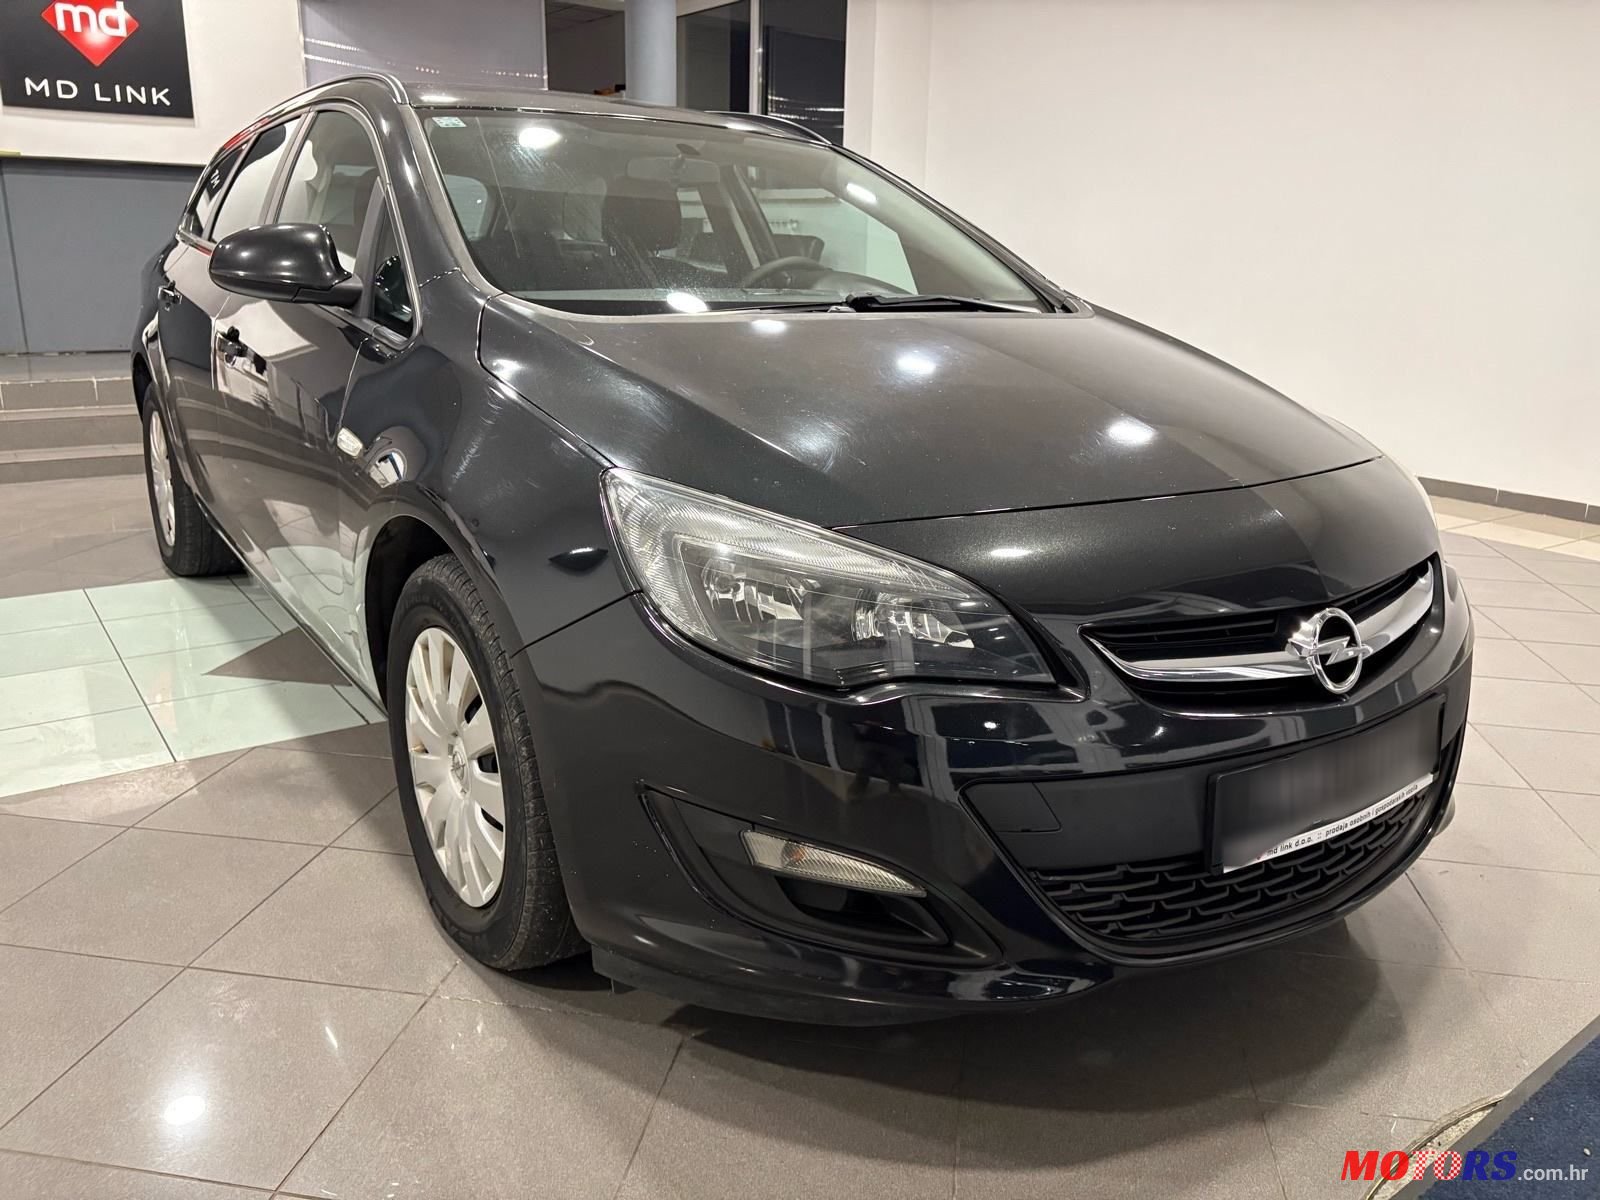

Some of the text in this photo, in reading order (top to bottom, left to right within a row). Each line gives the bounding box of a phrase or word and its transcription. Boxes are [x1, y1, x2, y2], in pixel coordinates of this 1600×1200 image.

[54, 1, 128, 37] md
[24, 77, 171, 106] MD LINK
[1280, 842, 1293, 852] link
[1325, 822, 1349, 837] prodaja
